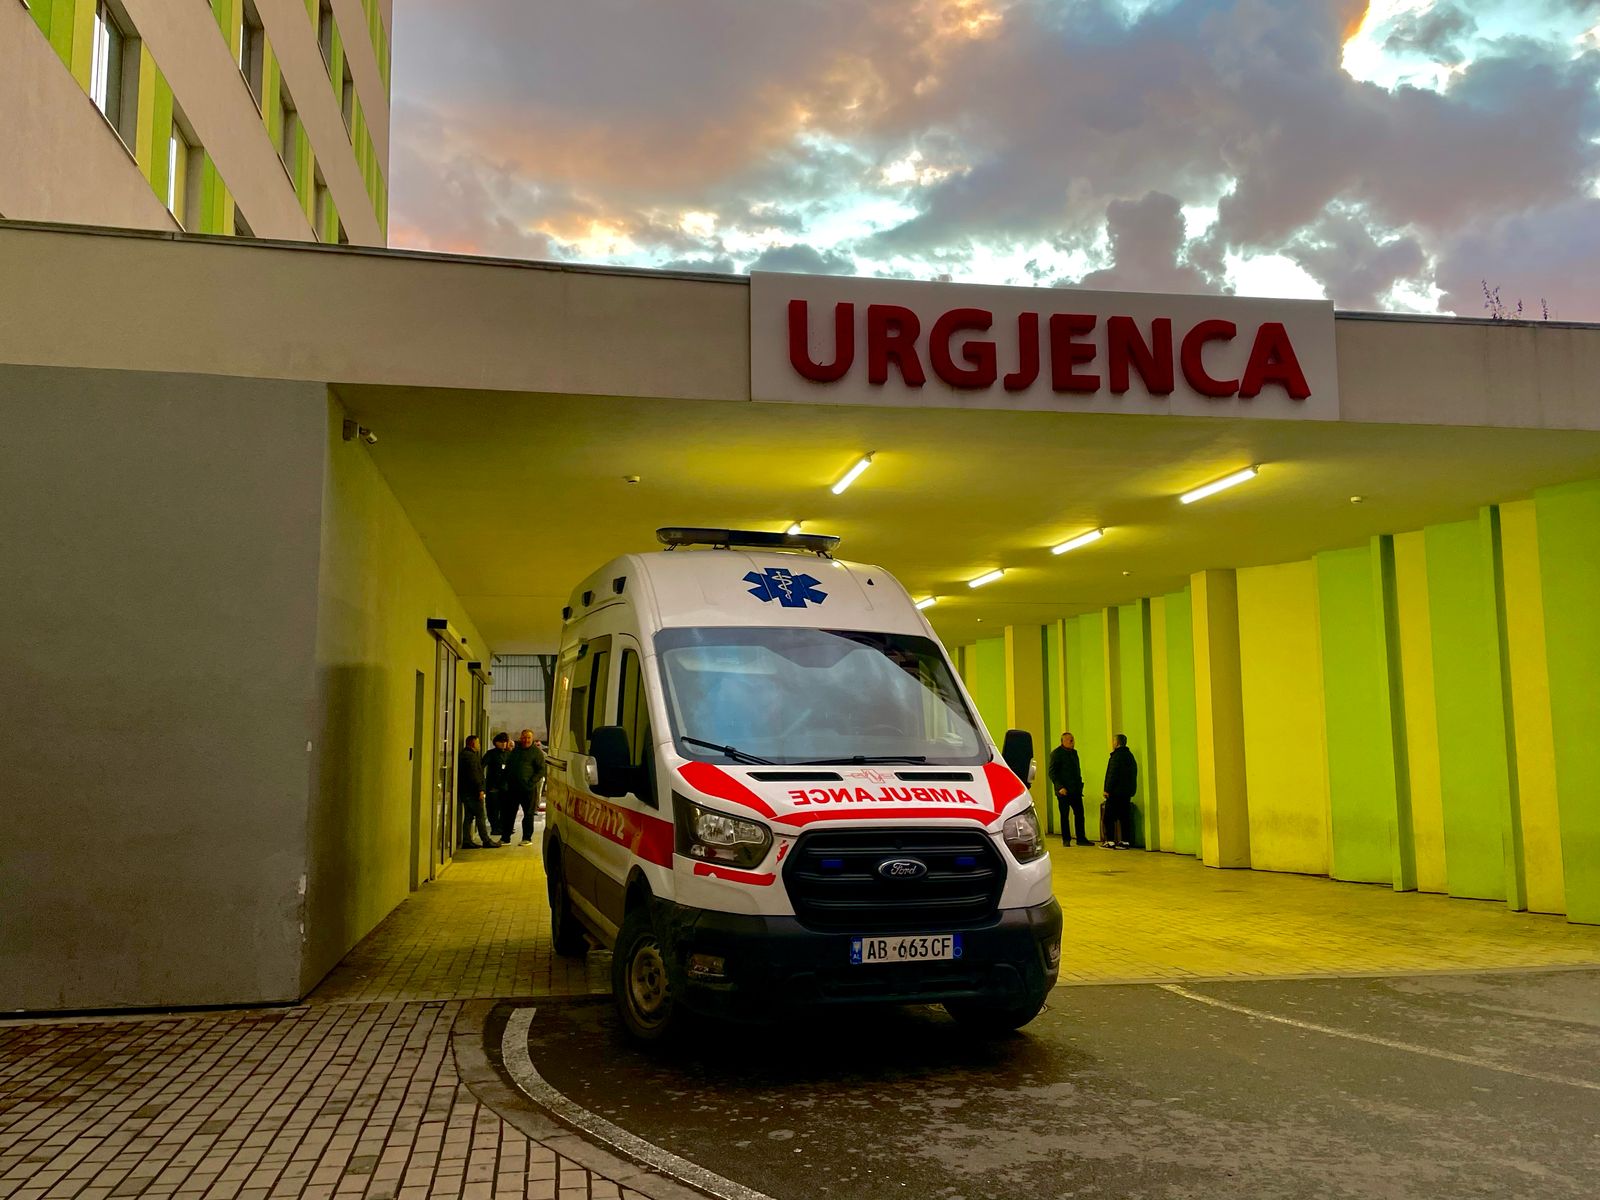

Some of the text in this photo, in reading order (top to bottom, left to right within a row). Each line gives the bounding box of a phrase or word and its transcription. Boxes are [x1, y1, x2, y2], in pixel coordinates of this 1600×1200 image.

[788, 299, 1311, 400] URGJENCA
[890, 862, 917, 875] Ford
[867, 940, 888, 960] AB
